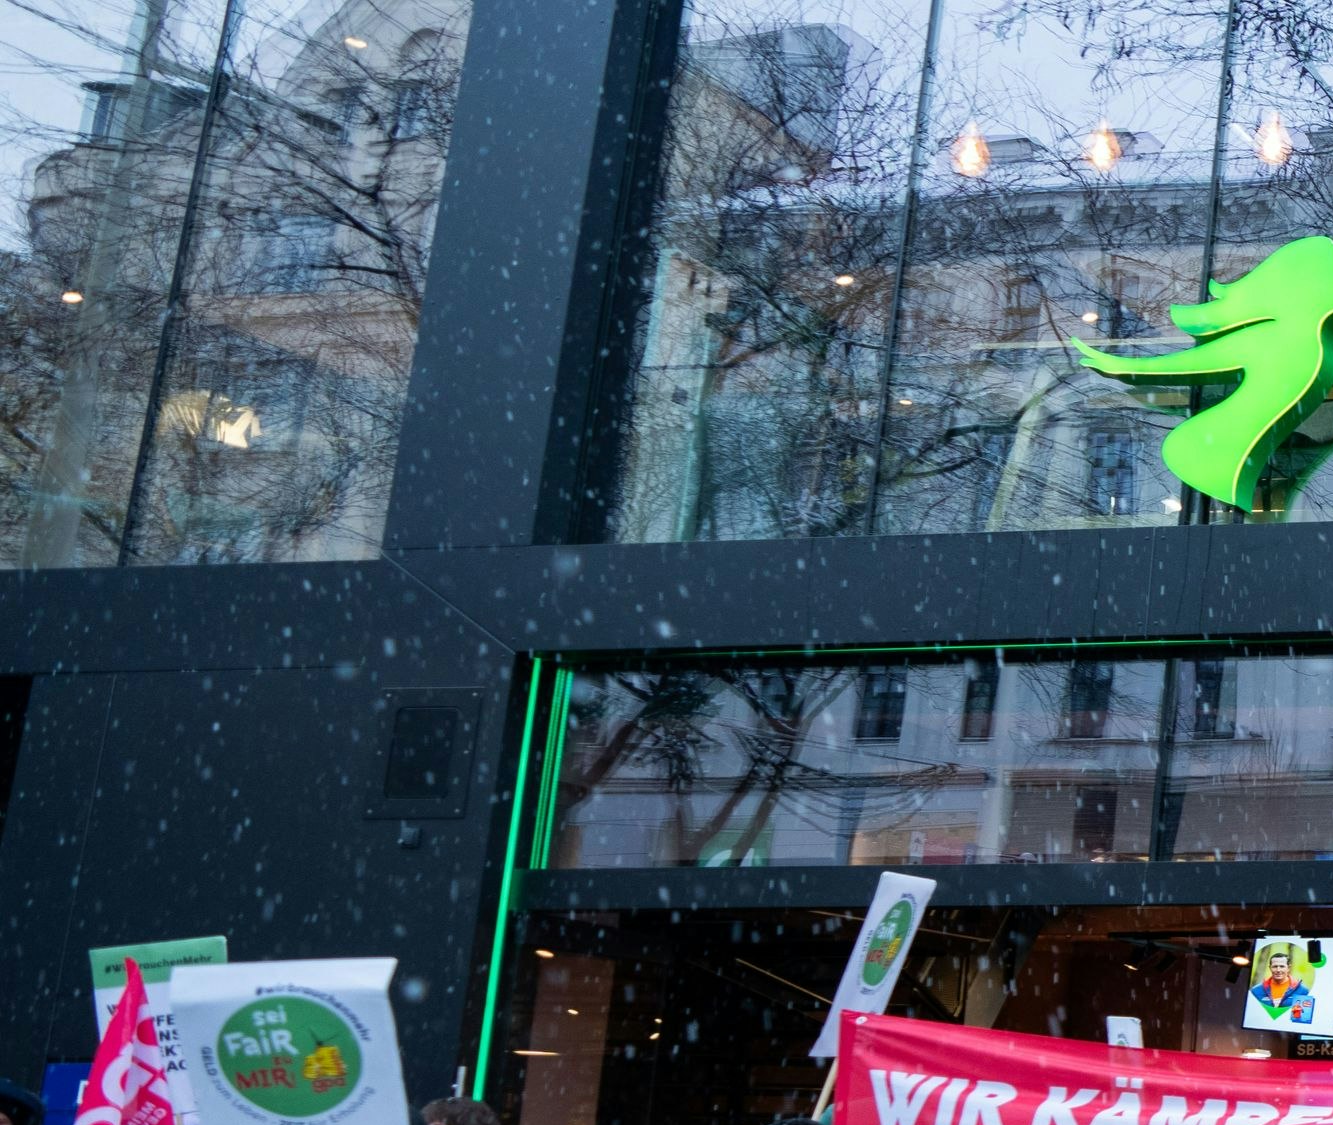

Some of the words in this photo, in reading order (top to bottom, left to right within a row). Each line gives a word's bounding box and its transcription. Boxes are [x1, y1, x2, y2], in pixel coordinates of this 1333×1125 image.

[252, 1004, 288, 1027] sei
[201, 1046, 218, 1077] GELD
[234, 1067, 296, 1090] MIR!
